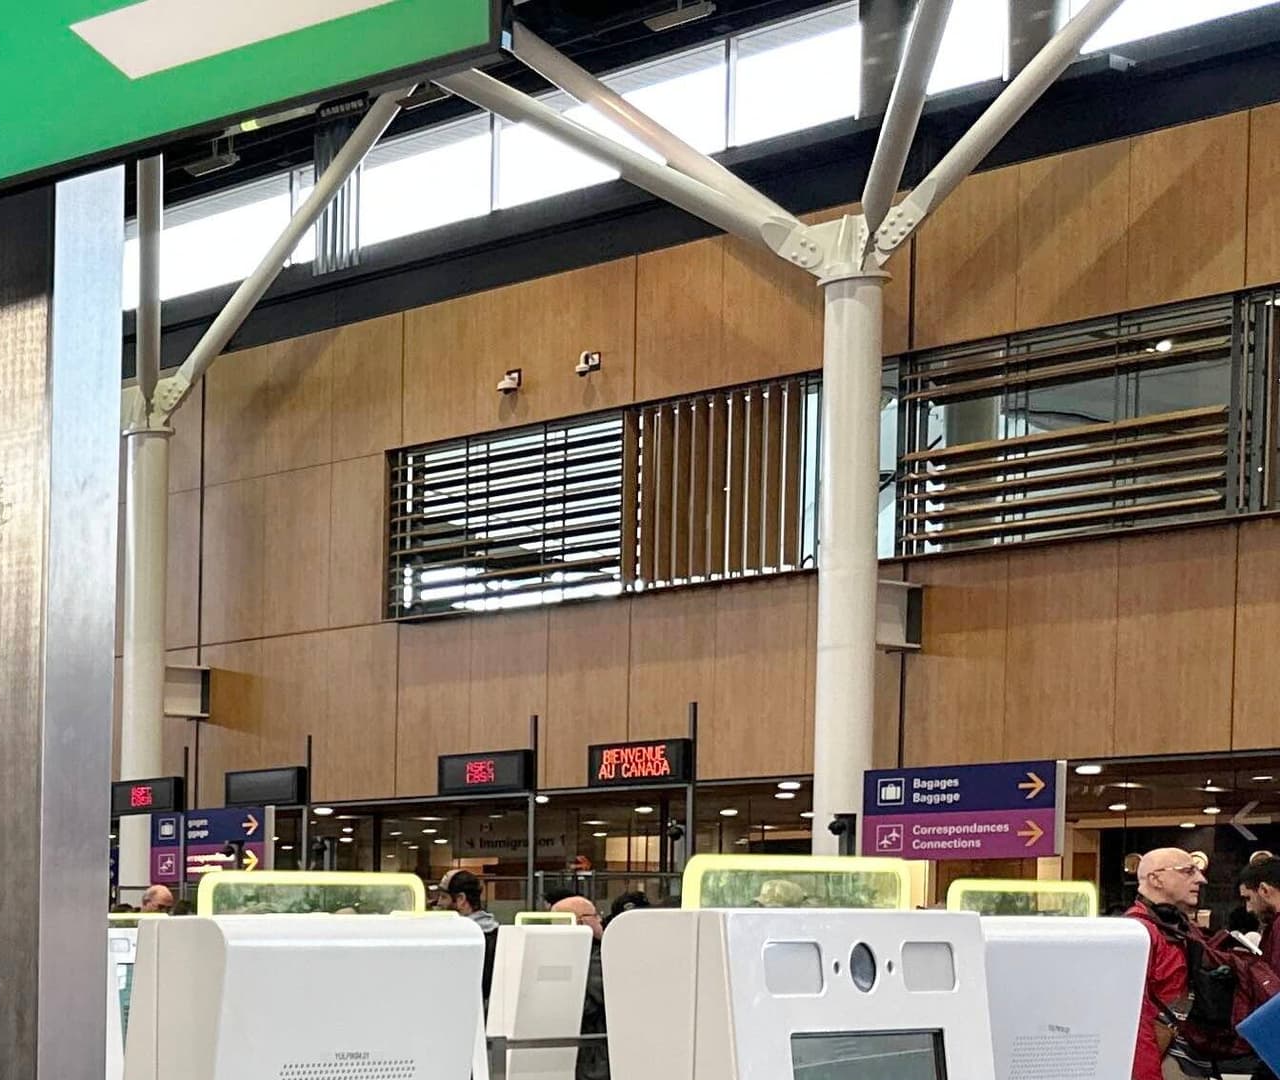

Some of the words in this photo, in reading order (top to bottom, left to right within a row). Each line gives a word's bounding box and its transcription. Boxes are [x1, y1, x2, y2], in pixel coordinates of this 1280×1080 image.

[602, 744, 668, 764] BIENVENUE
[598, 763, 616, 779] AU
[621, 759, 671, 779] CANADA
[912, 776, 960, 791] Bagages
[912, 791, 961, 805] Baggage
[912, 822, 1010, 837] Correspondances
[912, 837, 982, 851] Connections
